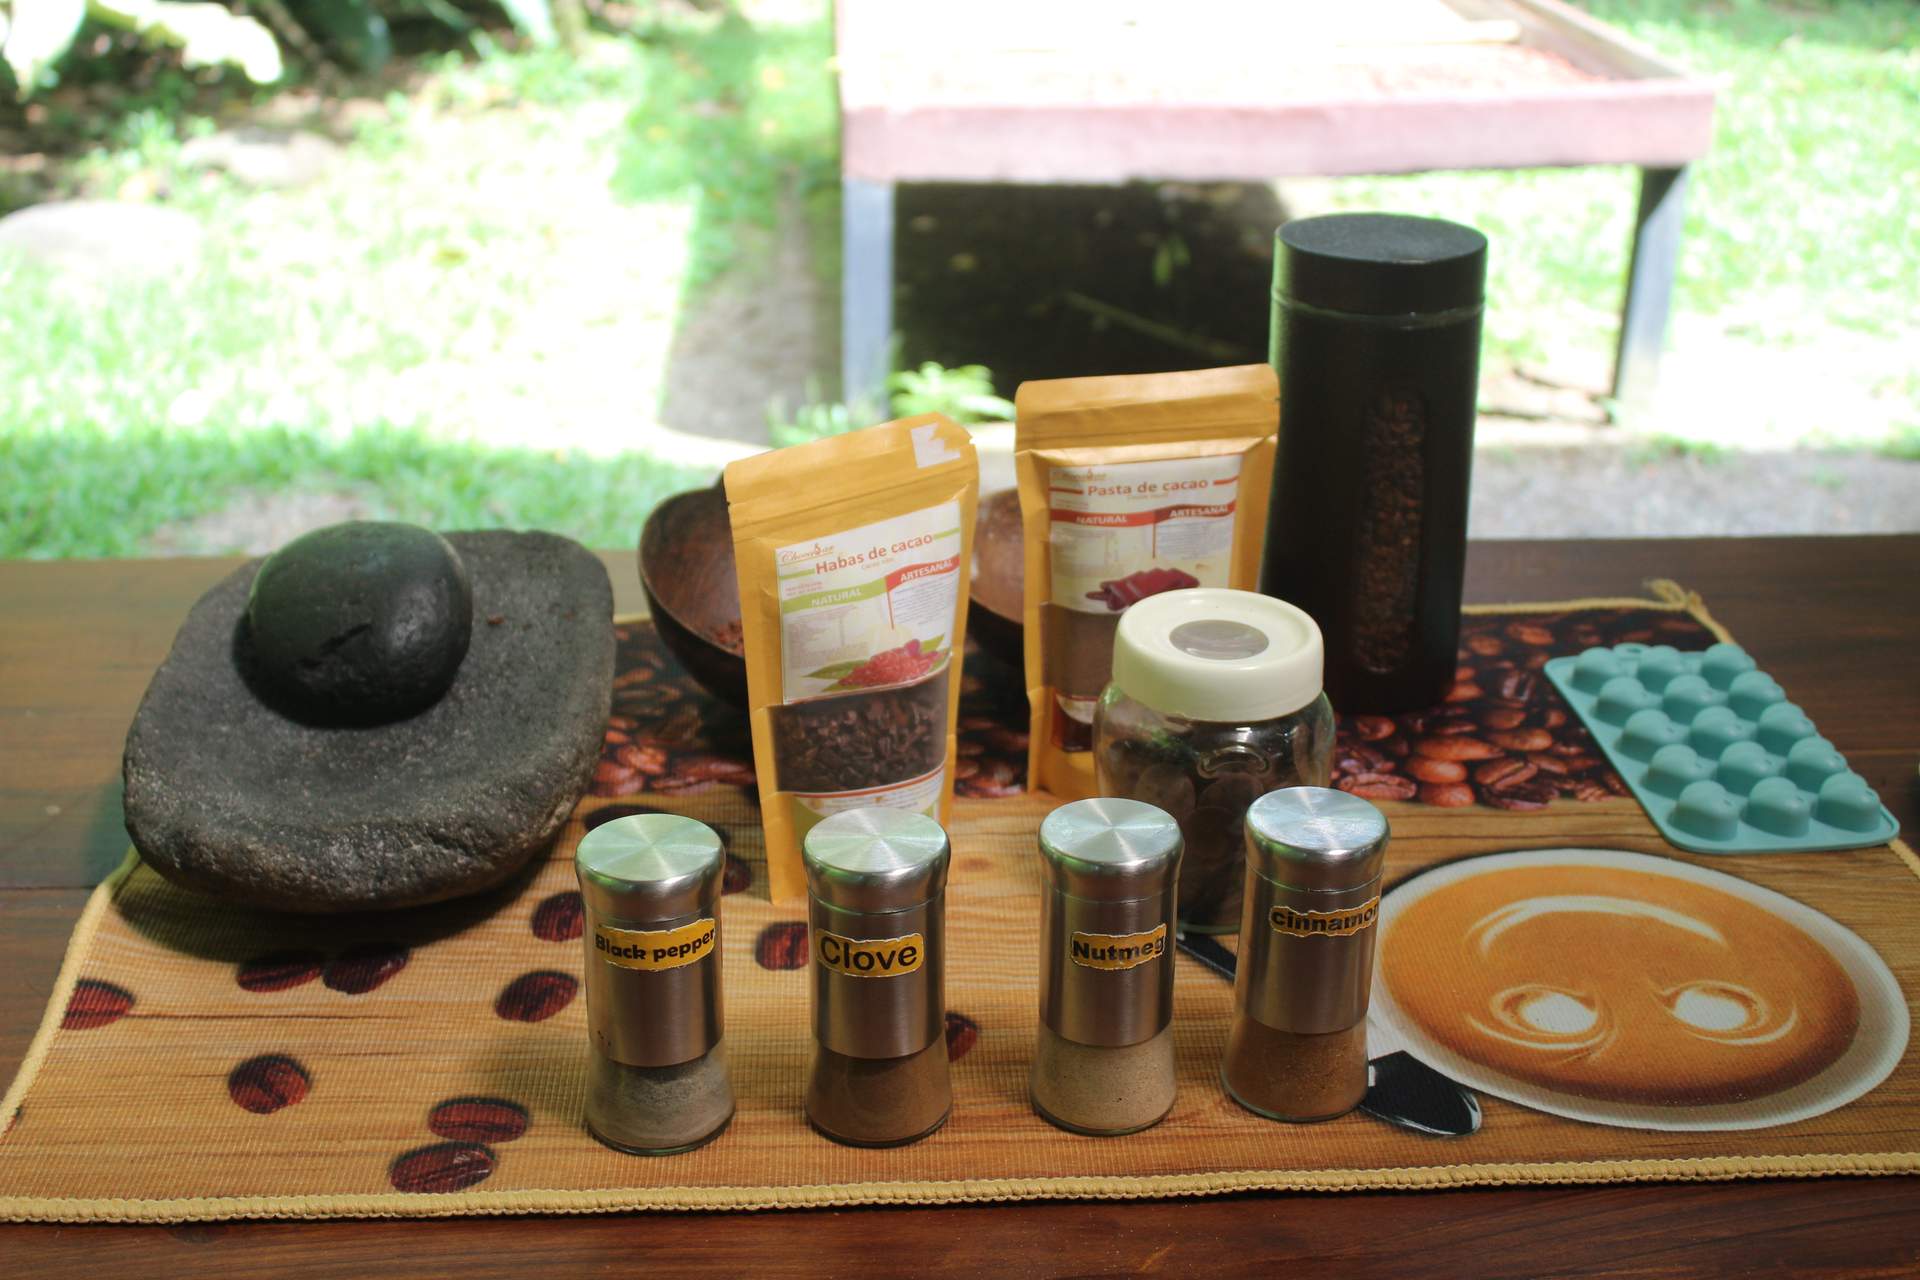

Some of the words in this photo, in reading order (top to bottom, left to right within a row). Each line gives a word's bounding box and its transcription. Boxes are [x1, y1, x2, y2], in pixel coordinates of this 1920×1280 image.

[1087, 484, 1132, 496] Pasta
[1137, 481, 1158, 494] de
[1162, 479, 1208, 492] cacao
[1076, 515, 1128, 525] NATURAL
[1169, 505, 1229, 518] ARTESANAL
[815, 552, 865, 575] Habas
[868, 545, 887, 560] de
[891, 534, 933, 553] cacao
[900, 559, 952, 582] ARTESANAL
[811, 587, 862, 607] NATURAL
[595, 933, 646, 960] Black
[653, 928, 715, 962] pepper
[820, 936, 917, 971] Clove
[1073, 936, 1165, 960] Nutmeg
